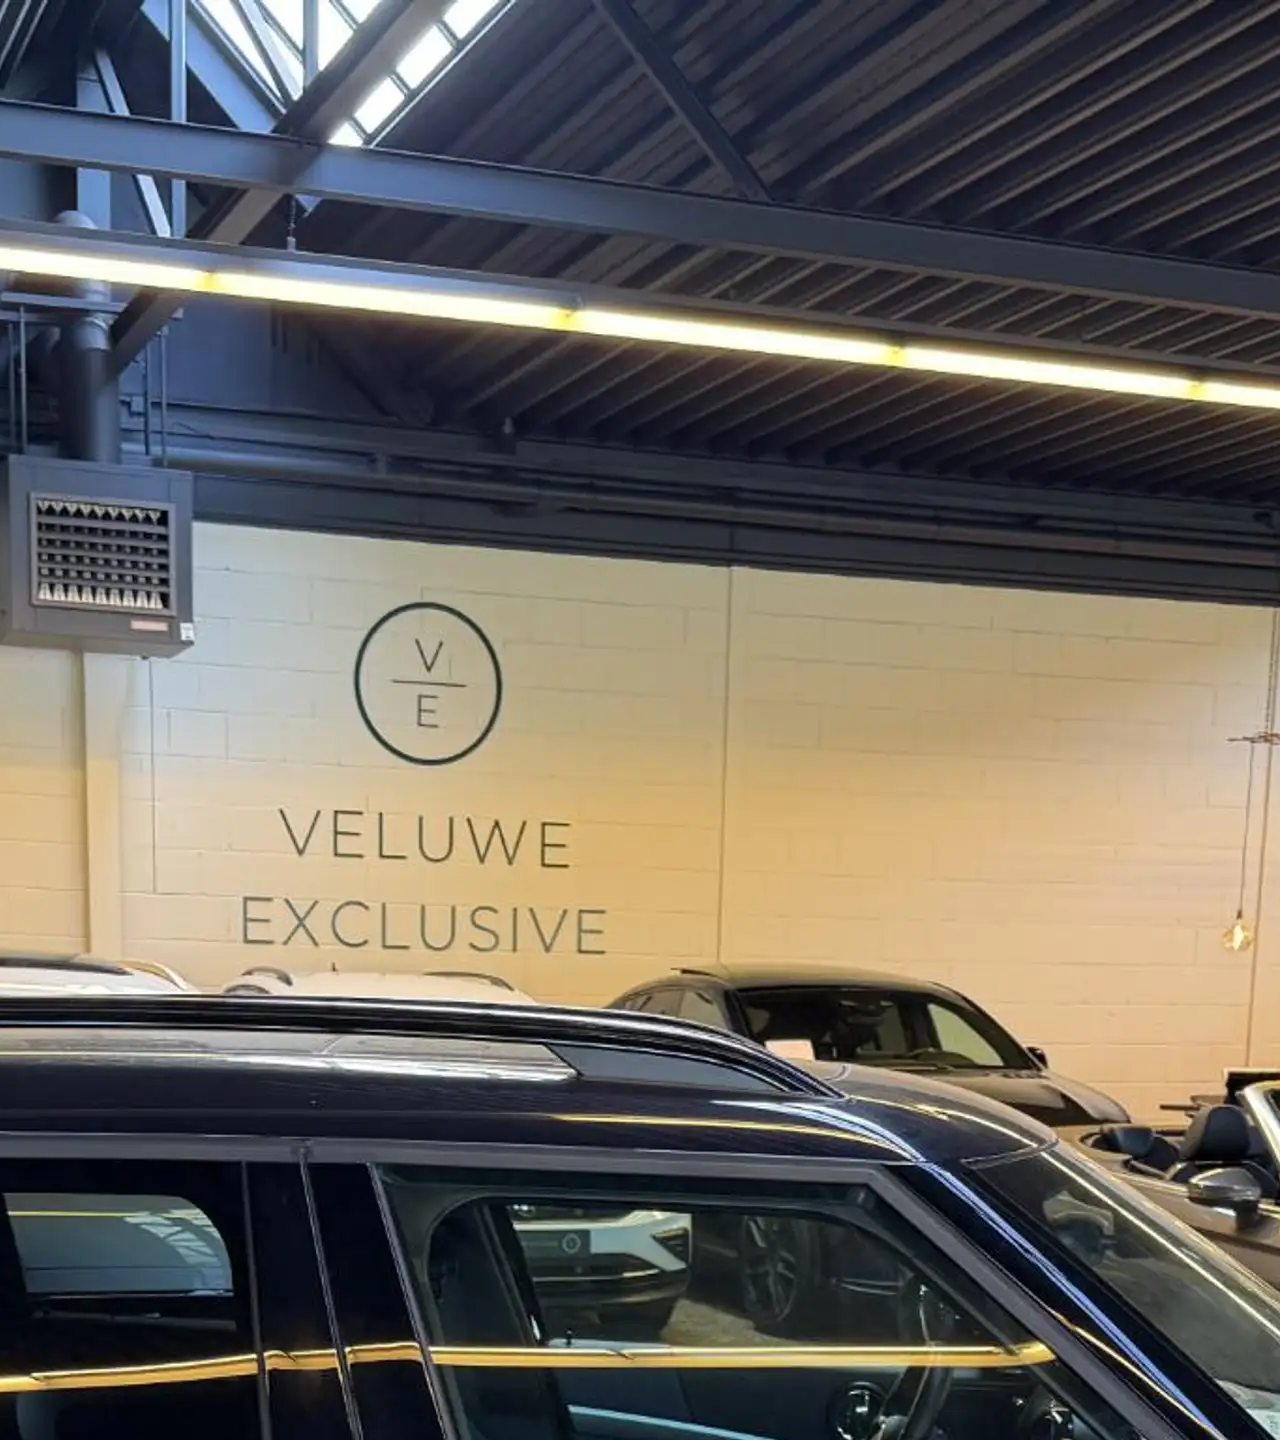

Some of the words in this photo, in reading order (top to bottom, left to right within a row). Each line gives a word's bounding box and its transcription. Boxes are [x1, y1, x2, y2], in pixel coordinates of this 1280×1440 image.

[414, 637, 444, 674] V
[416, 694, 440, 728] E
[278, 808, 572, 869] VELUWE
[241, 896, 608, 955] EXCLUSIVE
